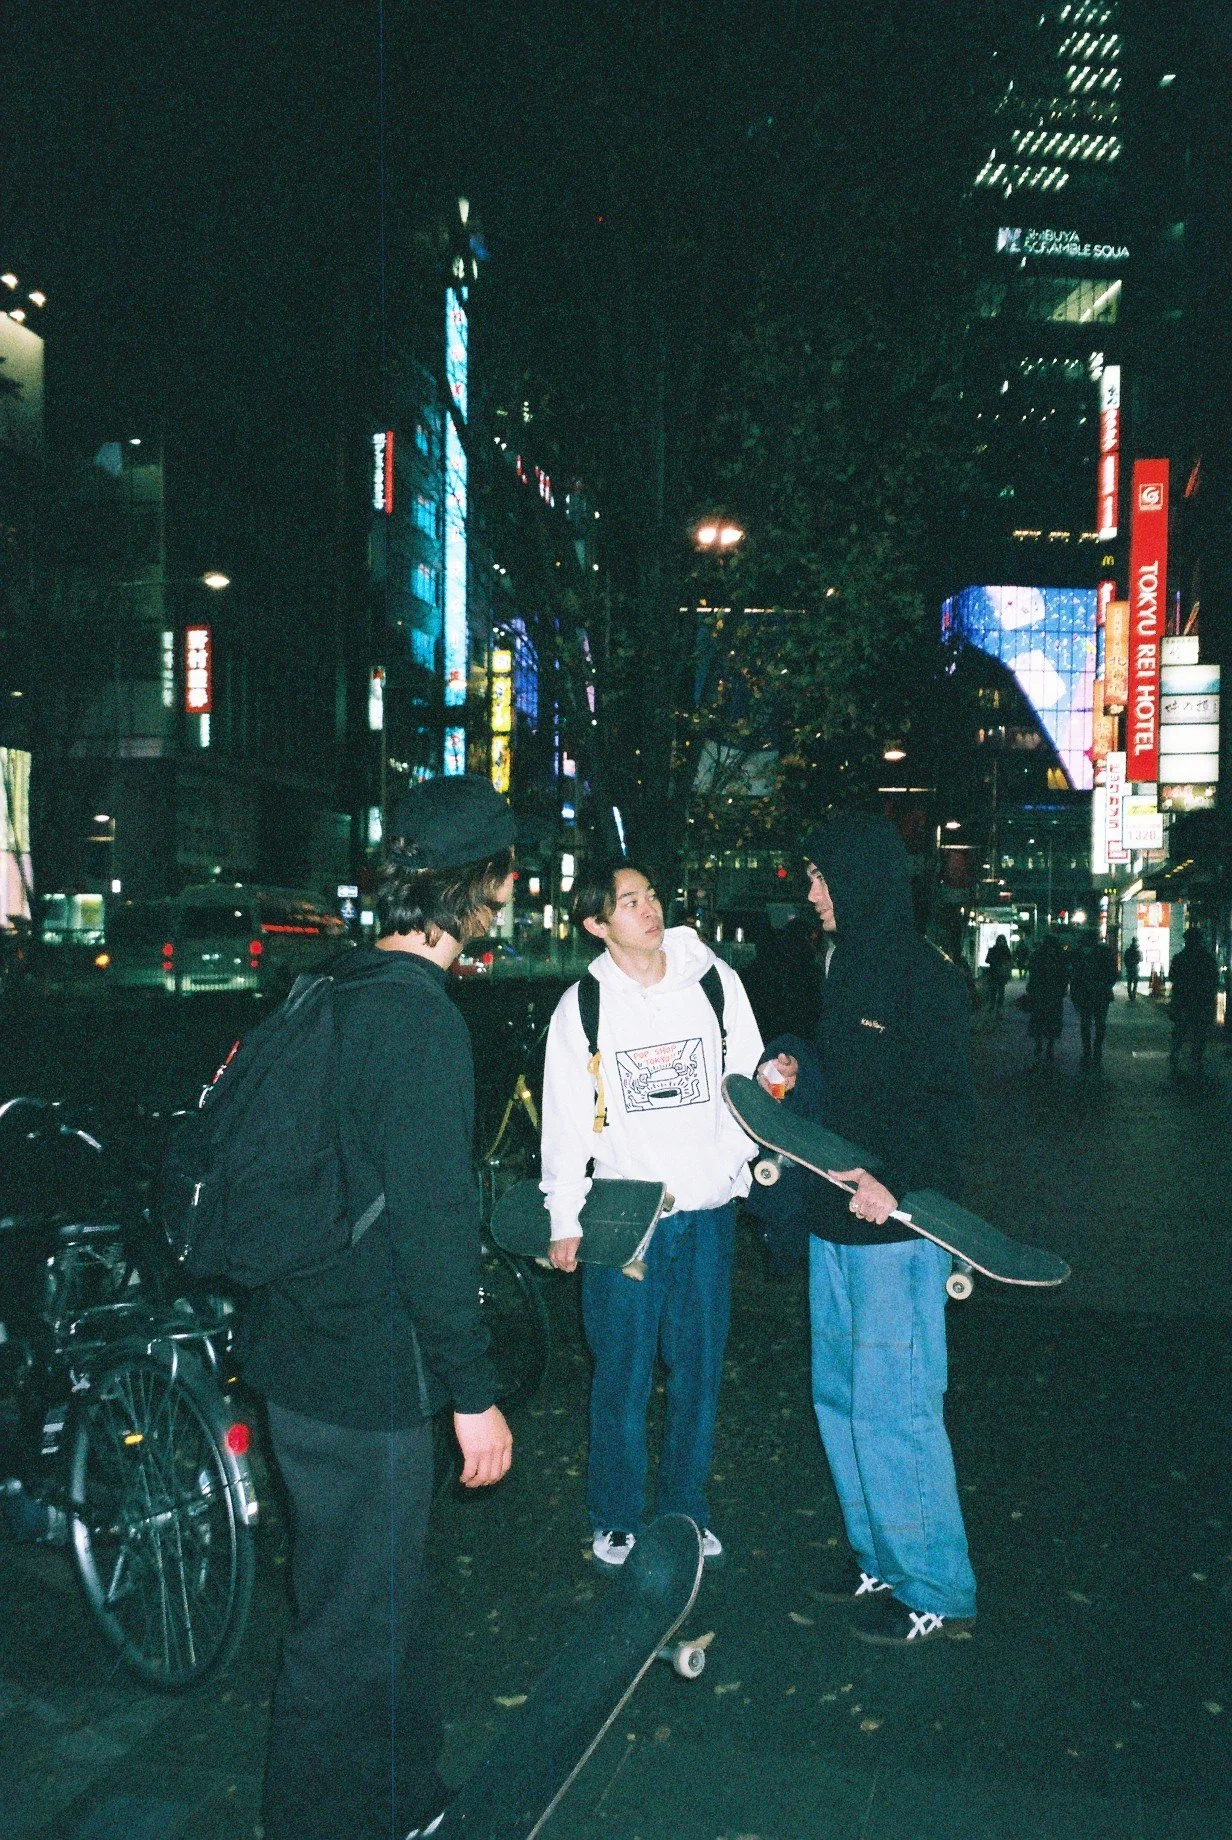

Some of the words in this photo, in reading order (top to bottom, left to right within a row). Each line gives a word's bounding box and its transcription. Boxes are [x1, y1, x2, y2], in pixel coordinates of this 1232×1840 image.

[1138, 560, 1159, 636] TOKYU
[1136, 643, 1156, 678] REI
[1134, 685, 1155, 756] HOTEL
[633, 1050, 649, 1060] POP
[655, 1045, 676, 1055] SHOP
